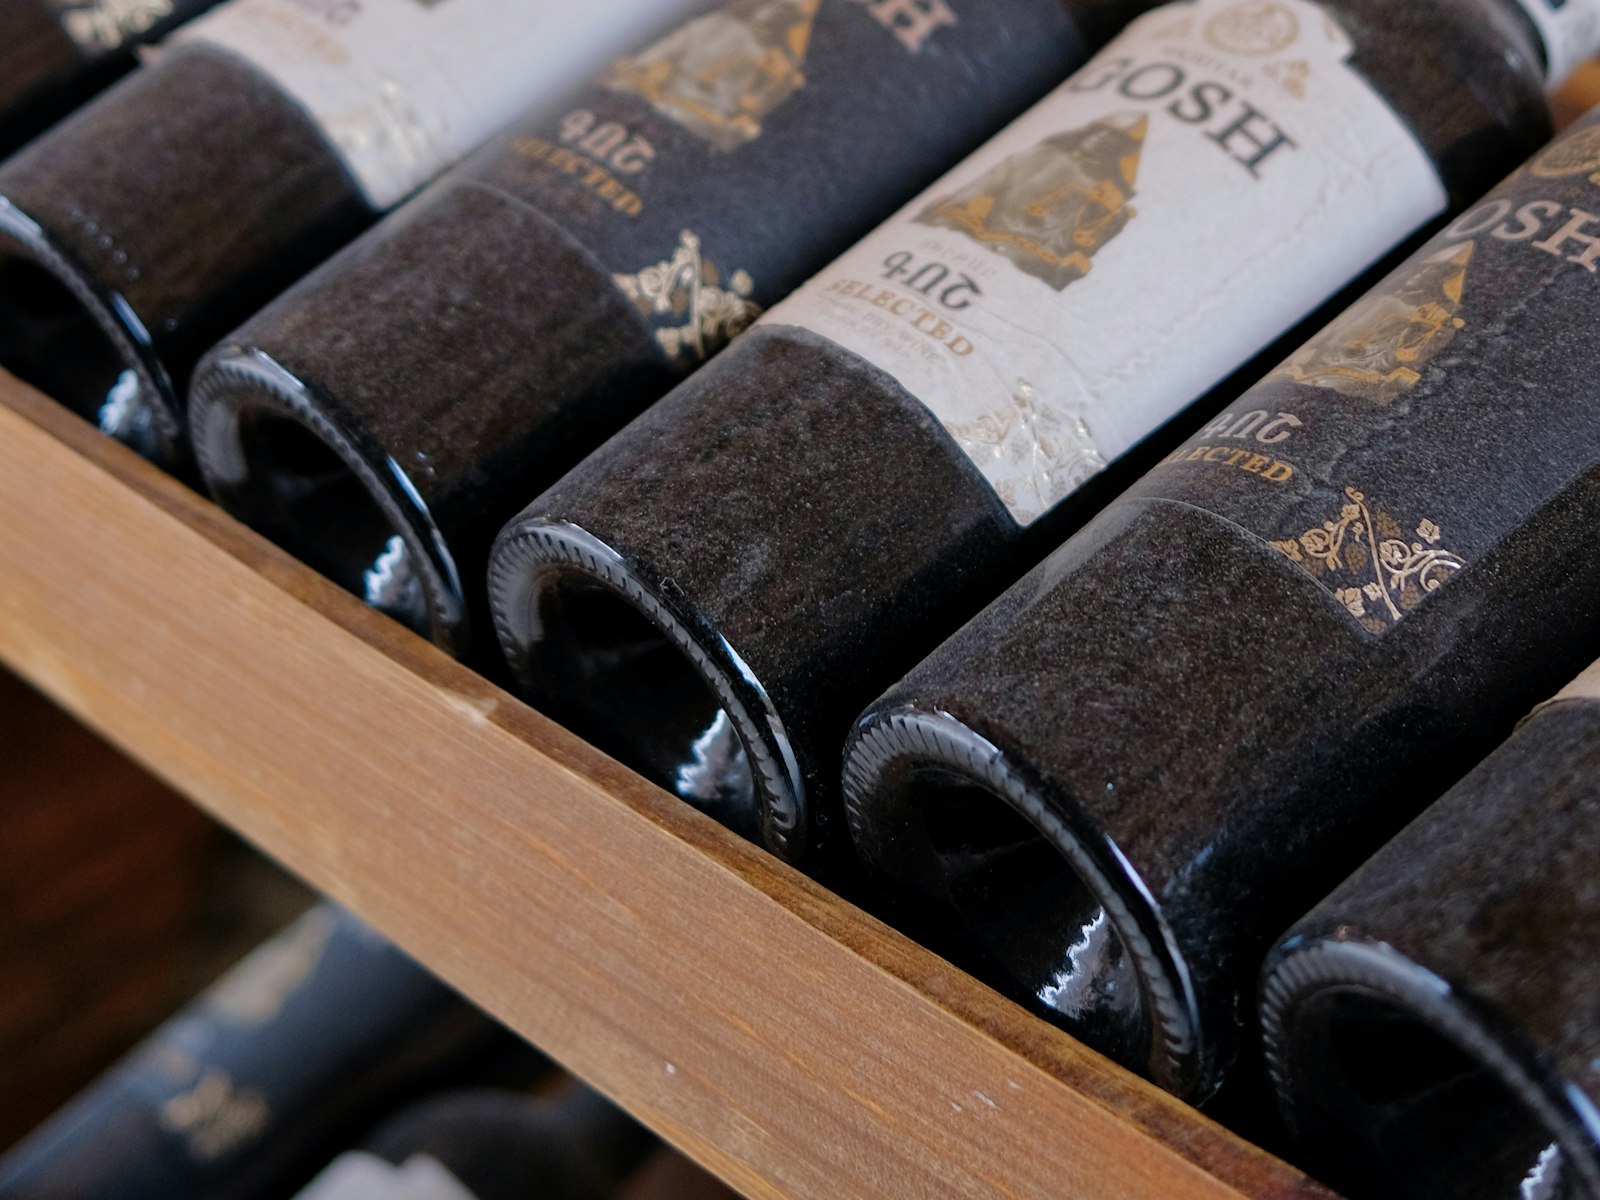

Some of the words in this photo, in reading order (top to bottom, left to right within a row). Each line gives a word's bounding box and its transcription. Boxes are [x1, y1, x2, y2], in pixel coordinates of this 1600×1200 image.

[1444, 200, 1600, 273] OSH
[825, 277, 974, 356] SELECTED
[1162, 445, 1294, 482] LECTED
